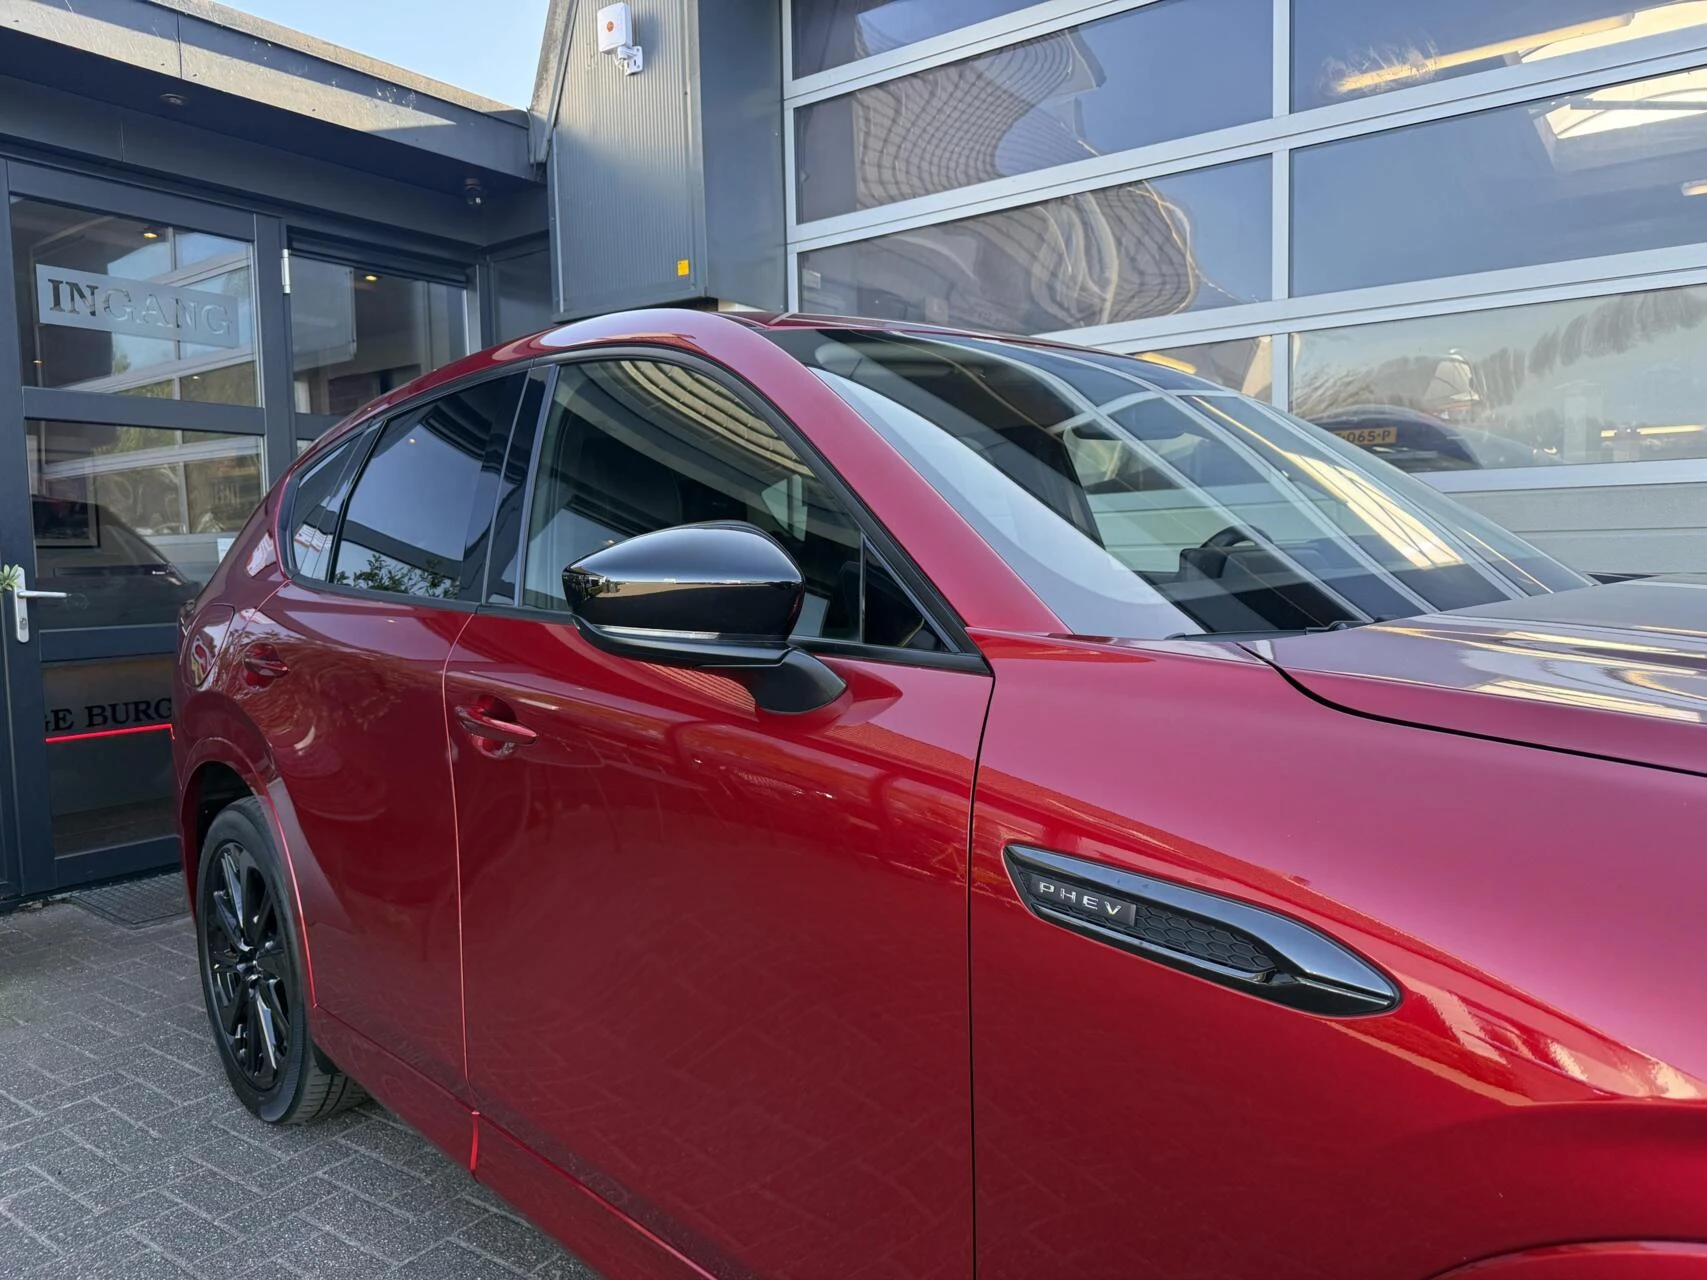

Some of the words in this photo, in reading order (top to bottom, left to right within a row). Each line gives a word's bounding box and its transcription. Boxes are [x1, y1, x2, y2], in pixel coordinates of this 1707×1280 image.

[47, 278, 232, 335] INGANG
[1335, 430, 1391, 443] -065-P
[45, 708, 74, 732] E
[85, 698, 171, 727] BURG
[1039, 881, 1121, 915] PHEV
